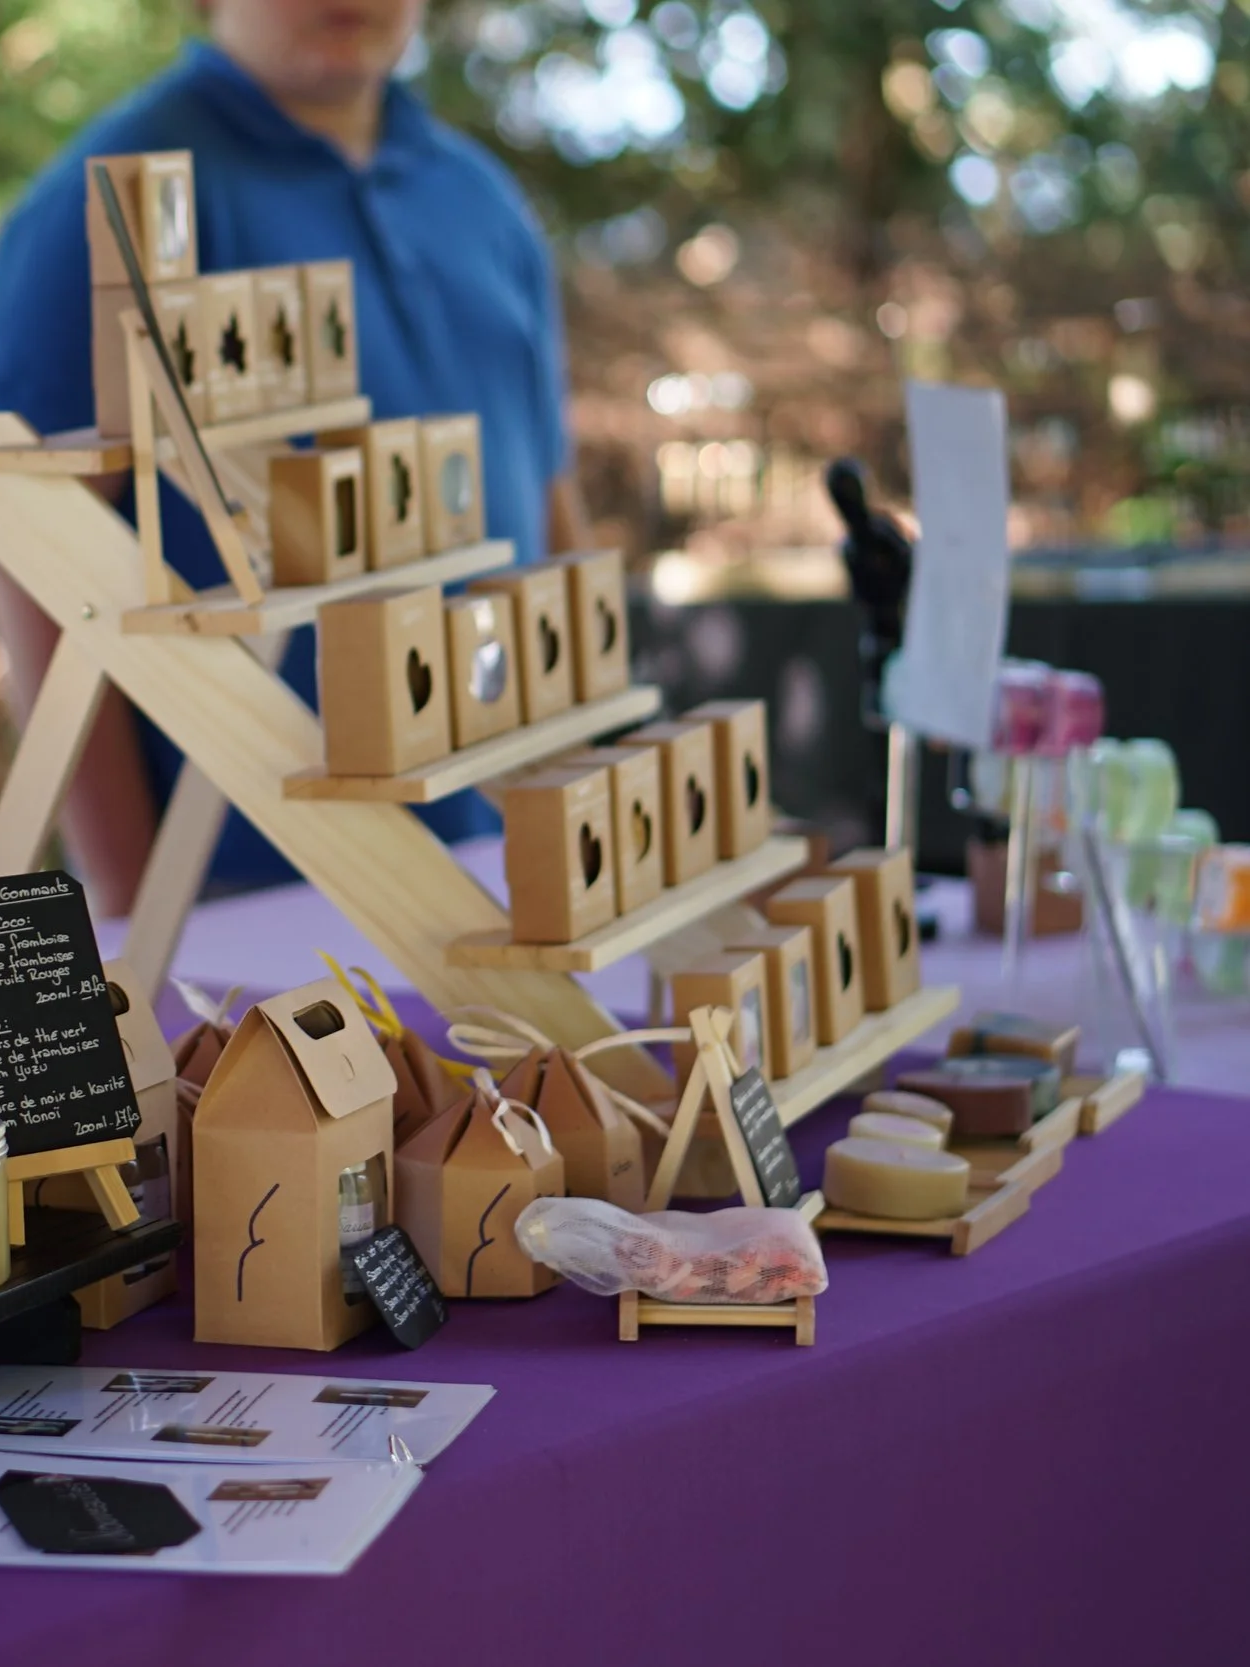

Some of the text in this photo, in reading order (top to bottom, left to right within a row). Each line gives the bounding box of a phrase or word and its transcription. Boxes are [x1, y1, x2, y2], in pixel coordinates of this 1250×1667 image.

[0, 877, 69, 900] Gommants
[10, 932, 70, 957] framboise
[7, 952, 75, 973] framboises
[27, 966, 70, 986] Rouges
[14, 1033, 30, 1047] de
[61, 1022, 87, 1039] vert
[8, 1050, 26, 1064] de
[30, 1038, 100, 1065] framboises
[20, 1095, 37, 1109] de
[40, 1090, 66, 1105] noix
[69, 1086, 86, 1100] de
[73, 1115, 107, 1136] 200ml
